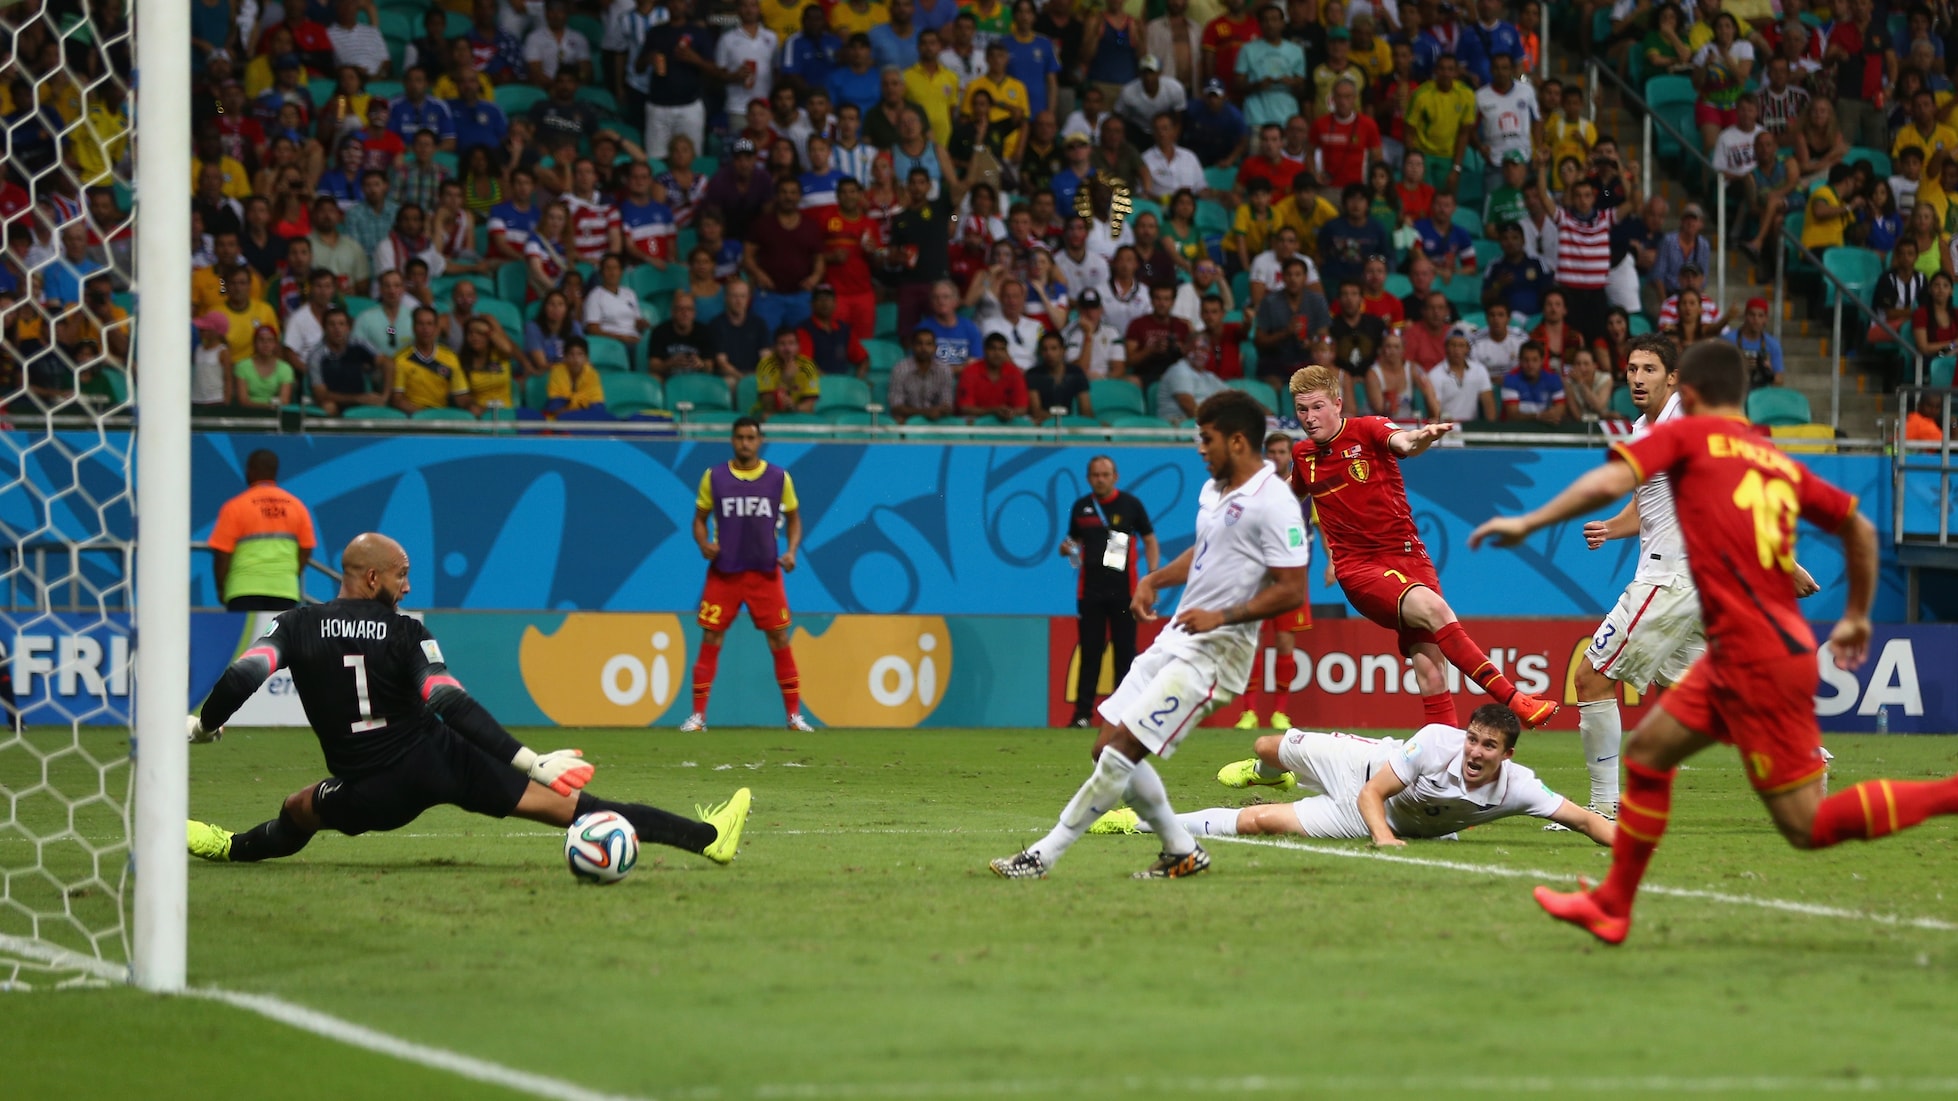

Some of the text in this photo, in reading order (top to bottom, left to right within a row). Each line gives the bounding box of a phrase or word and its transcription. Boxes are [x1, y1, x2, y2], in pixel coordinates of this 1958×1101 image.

[1305, 455, 1317, 483] 7
[720, 496, 773, 518] FIFA
[1733, 469, 1800, 573] 10
[1383, 569, 1408, 585] 7
[698, 601, 722, 624] 22
[320, 618, 388, 640] HOWARD
[1595, 623, 1617, 650] 3
[0, 634, 130, 696] FRI
[600, 631, 670, 706] oi
[868, 633, 937, 707] oi
[1811, 638, 1925, 717] SA
[343, 655, 388, 733] 1
[1149, 696, 1180, 728] 2
